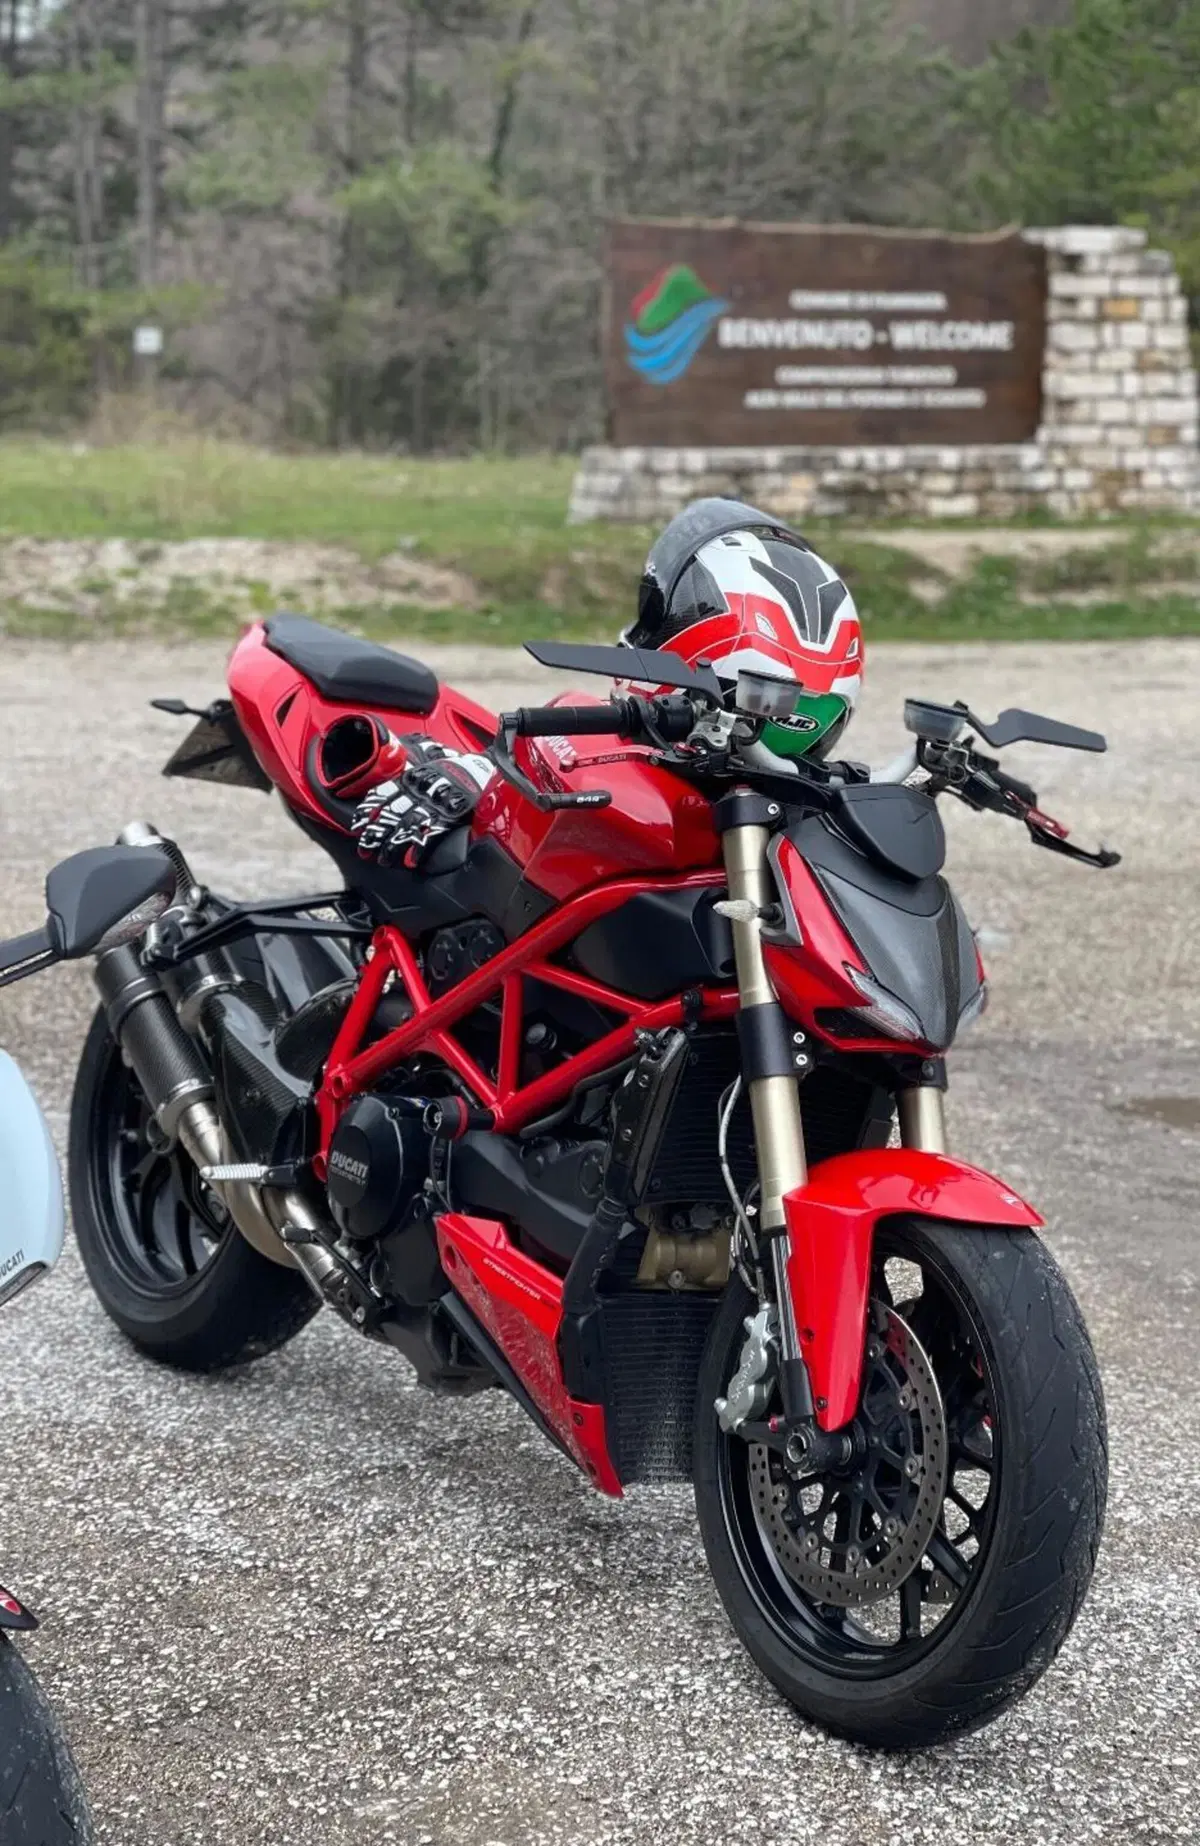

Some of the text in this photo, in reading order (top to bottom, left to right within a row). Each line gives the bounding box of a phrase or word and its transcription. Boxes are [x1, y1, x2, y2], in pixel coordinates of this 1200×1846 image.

[718, 319, 873, 349] BENVENUTO
[889, 321, 1013, 351] WELCOME
[598, 754, 627, 763] DUCATI
[331, 1150, 369, 1178] DUCATI
[0, 1248, 24, 1277] UCATI
[482, 1257, 541, 1301] STREETFIGHTER
